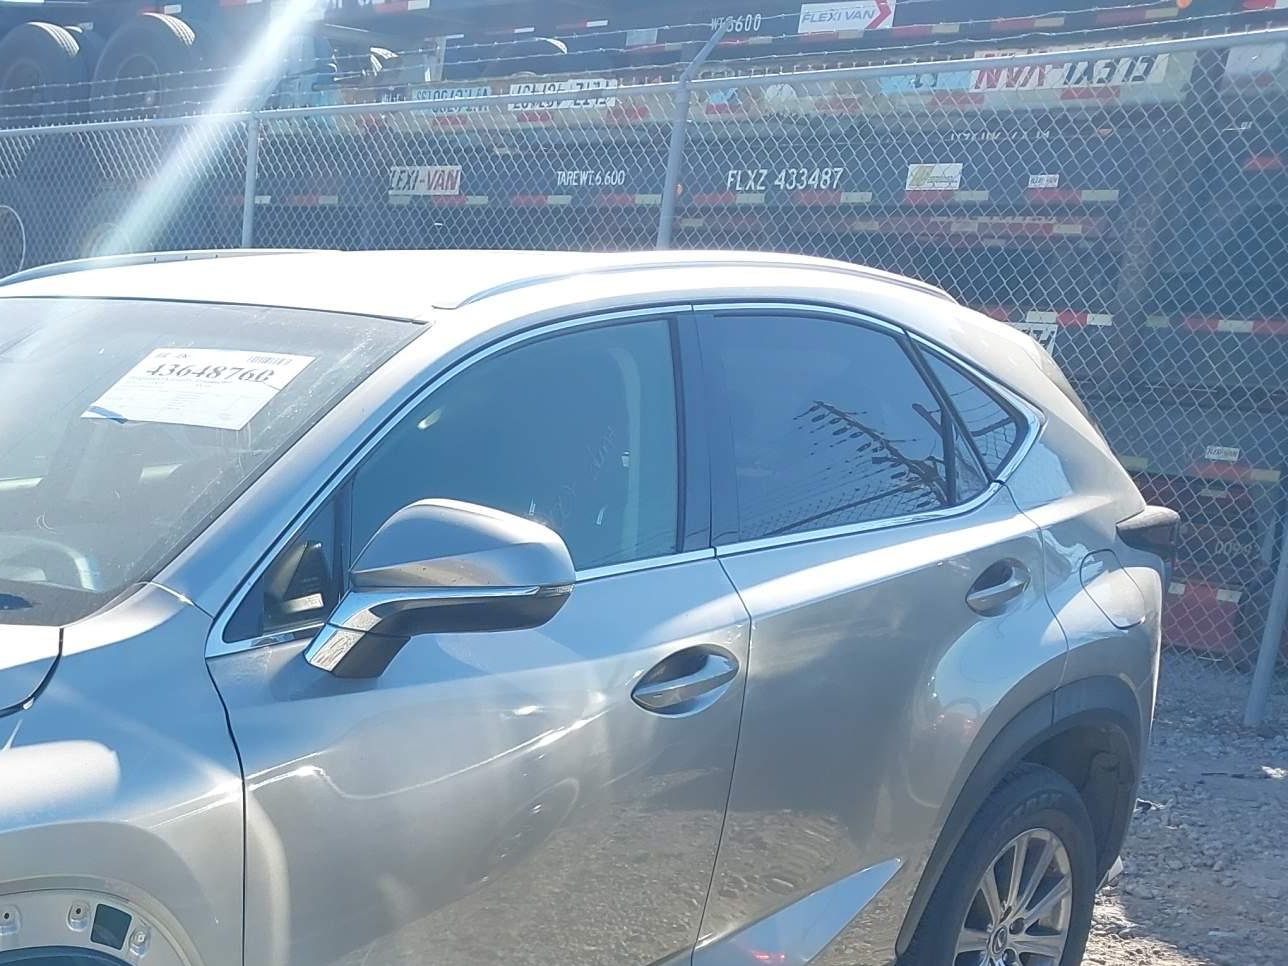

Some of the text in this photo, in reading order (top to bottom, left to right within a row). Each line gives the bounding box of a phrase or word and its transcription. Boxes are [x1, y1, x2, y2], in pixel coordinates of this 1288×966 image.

[802, 8, 876, 24] FLEXI VAN
[726, 167, 844, 191] FLXZ 433487
[146, 363, 275, 383] 43648760
